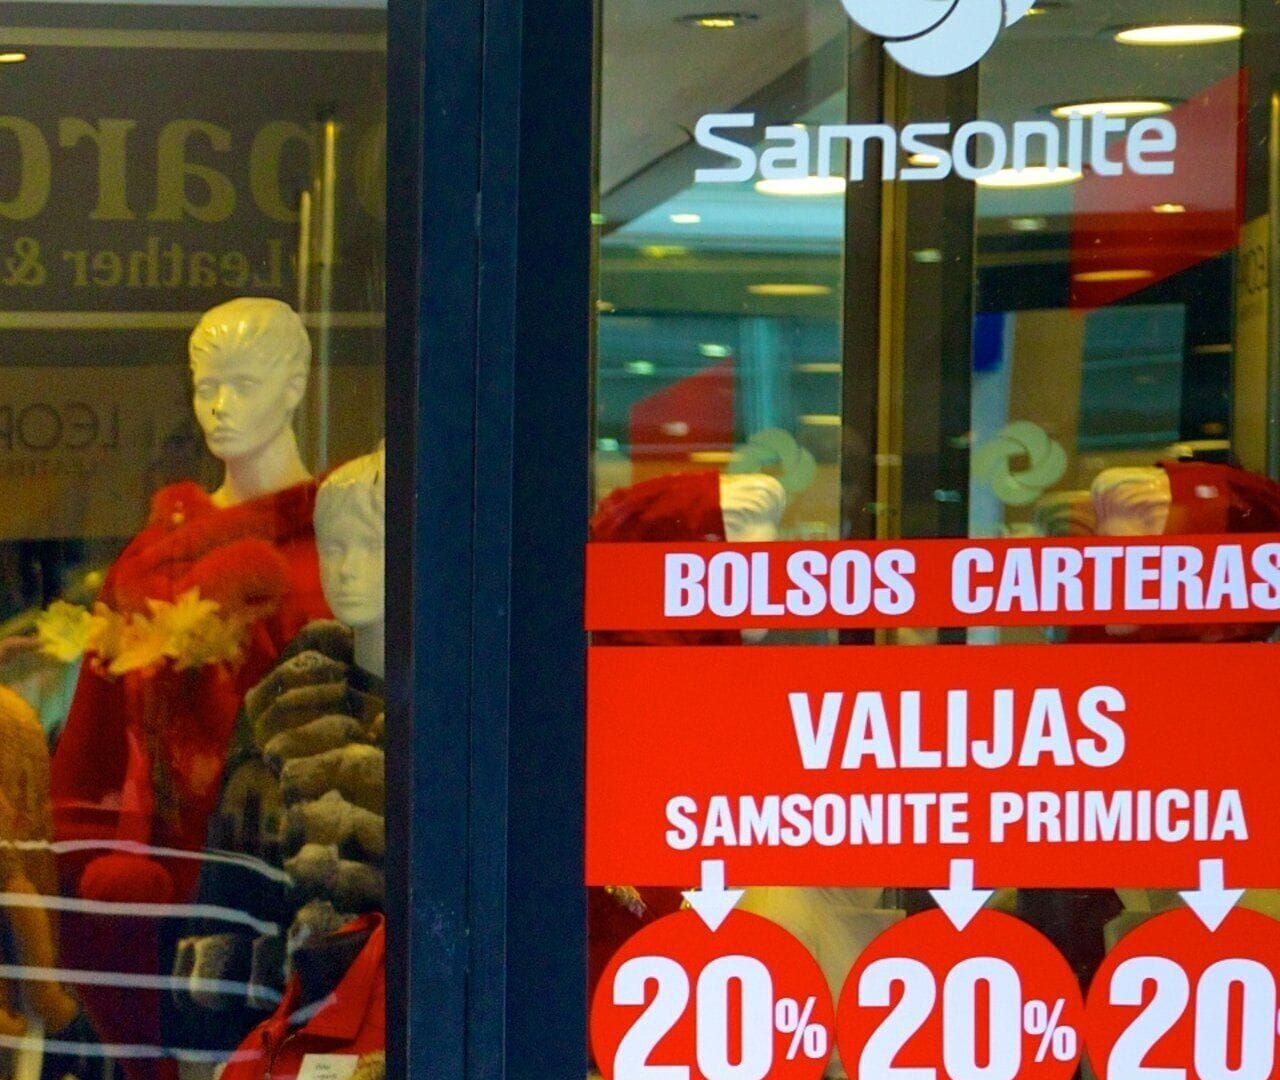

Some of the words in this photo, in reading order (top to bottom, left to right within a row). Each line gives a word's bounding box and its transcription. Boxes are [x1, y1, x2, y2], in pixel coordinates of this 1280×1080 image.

[693, 110, 1178, 183] Samsonite
[663, 548, 916, 618] BOLSOS
[951, 543, 1280, 614] CARTERAS
[788, 685, 1126, 770] VALIJAS
[665, 791, 970, 851] SAMSONITE
[989, 788, 1249, 843] PRIMICIA
